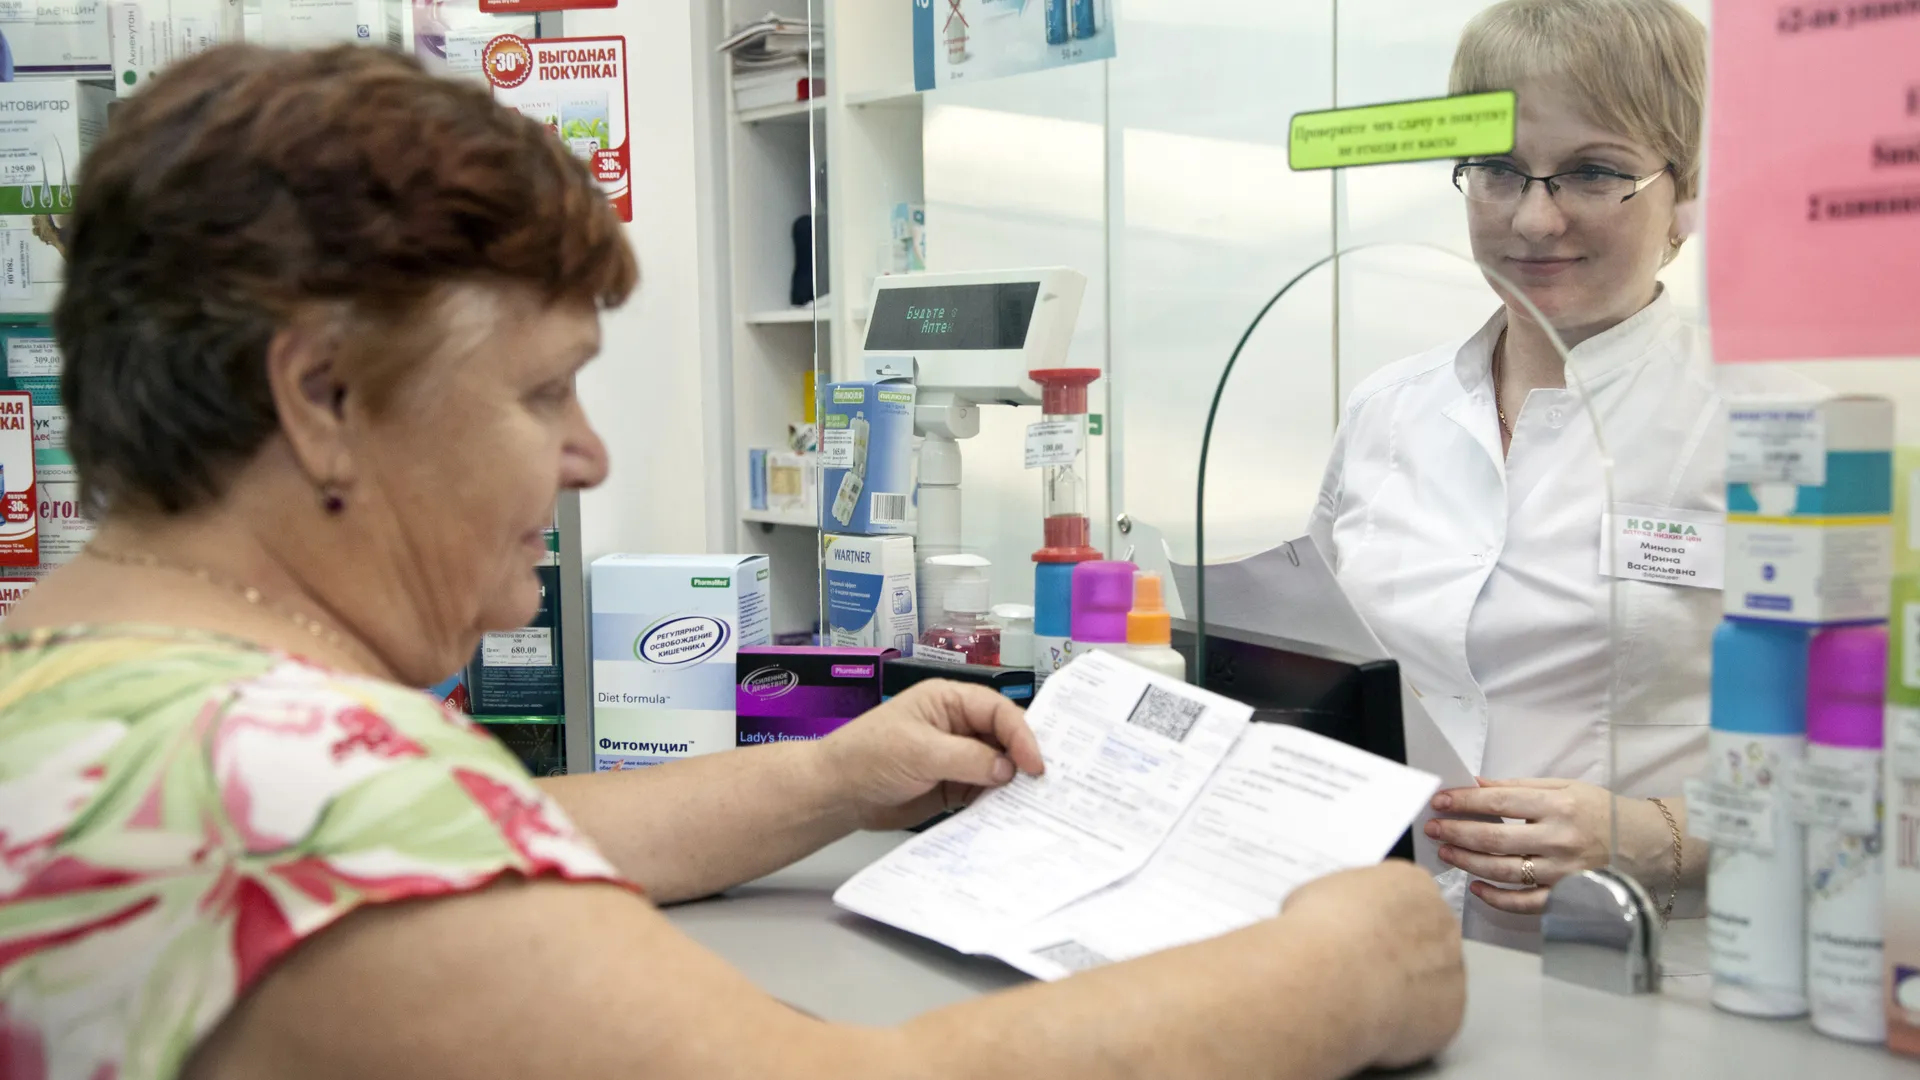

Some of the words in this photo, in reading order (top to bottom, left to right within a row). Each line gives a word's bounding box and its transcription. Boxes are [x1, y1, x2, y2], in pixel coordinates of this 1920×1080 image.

[128, 10, 137, 66] Акнекутан
[538, 47, 616, 64] ВЫГОДНАЯ
[538, 63, 617, 80] ПОКУПКА!
[598, 158, 621, 171] -30%
[906, 306, 945, 320] Будьте
[7, 500, 30, 512] -30%
[1626, 518, 1698, 536] НОРМА
[1639, 541, 1686, 554] Минова
[834, 548, 871, 563] WARTNER
[1643, 551, 1681, 565] Ирина
[1626, 561, 1697, 577] Васильевна
[693, 577, 730, 588] PharmaMed
[656, 623, 705, 641] РЕГУЛЯРНОЕ
[649, 630, 714, 651] ОСВОБОЖДЕНИЕ
[510, 646, 538, 654] 680.00
[657, 642, 706, 658] КИШЕЧНИКА
[751, 672, 788, 686] УСИЛЕННОЕ
[751, 679, 789, 692] ДЕЙСТВИЕ
[598, 692, 620, 703] Diet
